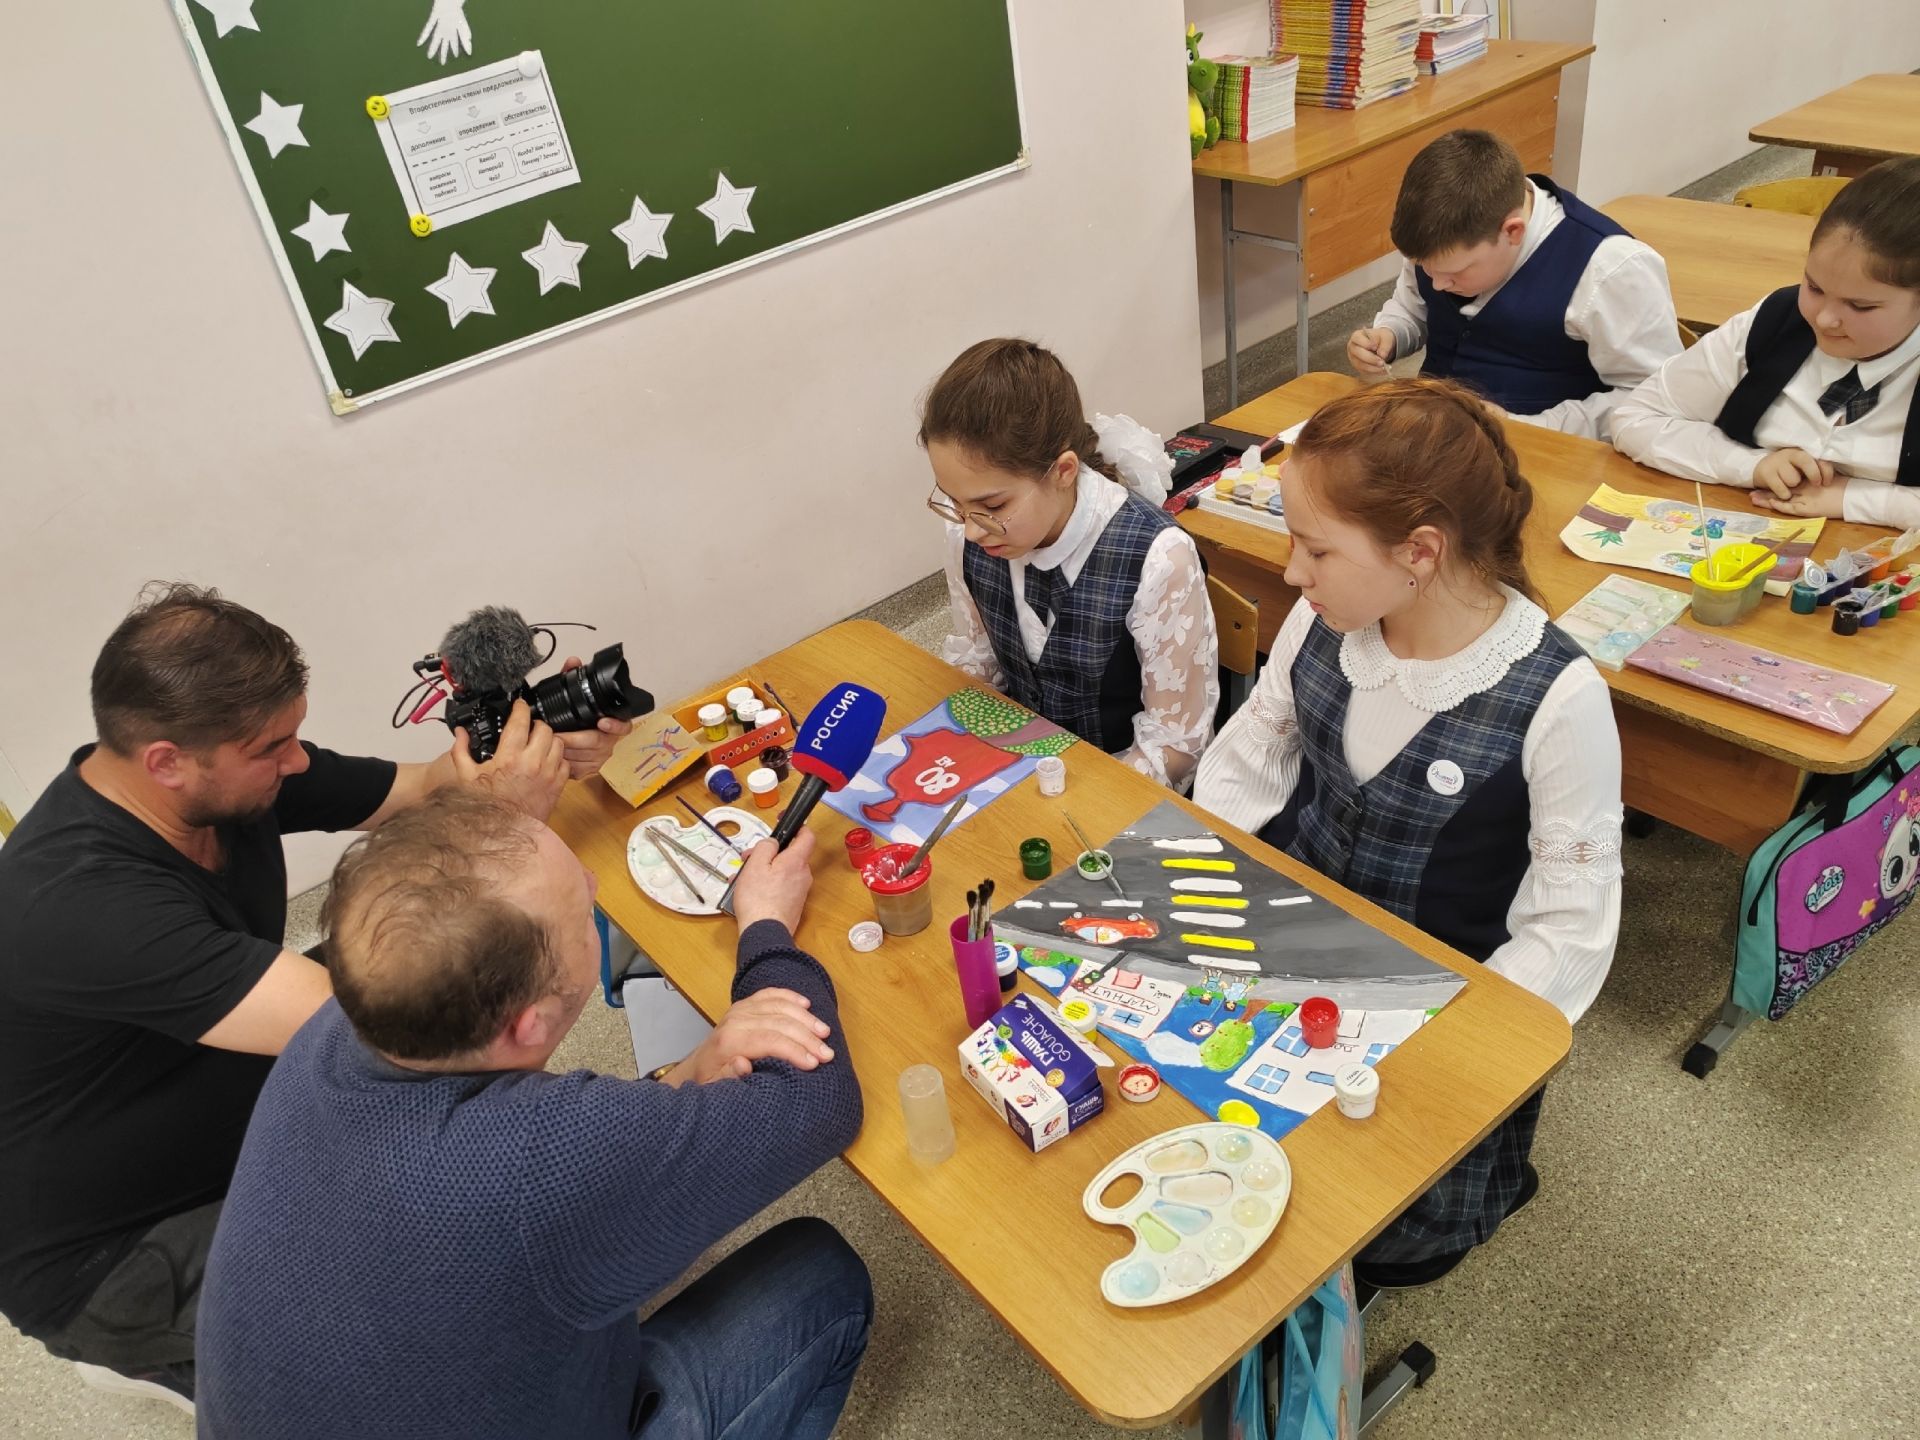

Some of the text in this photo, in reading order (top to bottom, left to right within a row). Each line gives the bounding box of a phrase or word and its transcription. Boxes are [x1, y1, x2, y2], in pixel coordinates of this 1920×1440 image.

[409, 77, 524, 115] Второстепенные члены предложения
[504, 103, 547, 122] обстоятельство
[411, 136, 446, 152] дополнение
[458, 120, 496, 136] определение
[811, 690, 860, 750] РОССИЯ
[1020, 1030, 1055, 1066] ГУАШЬ
[1021, 1013, 1071, 1062] GOUACHE
